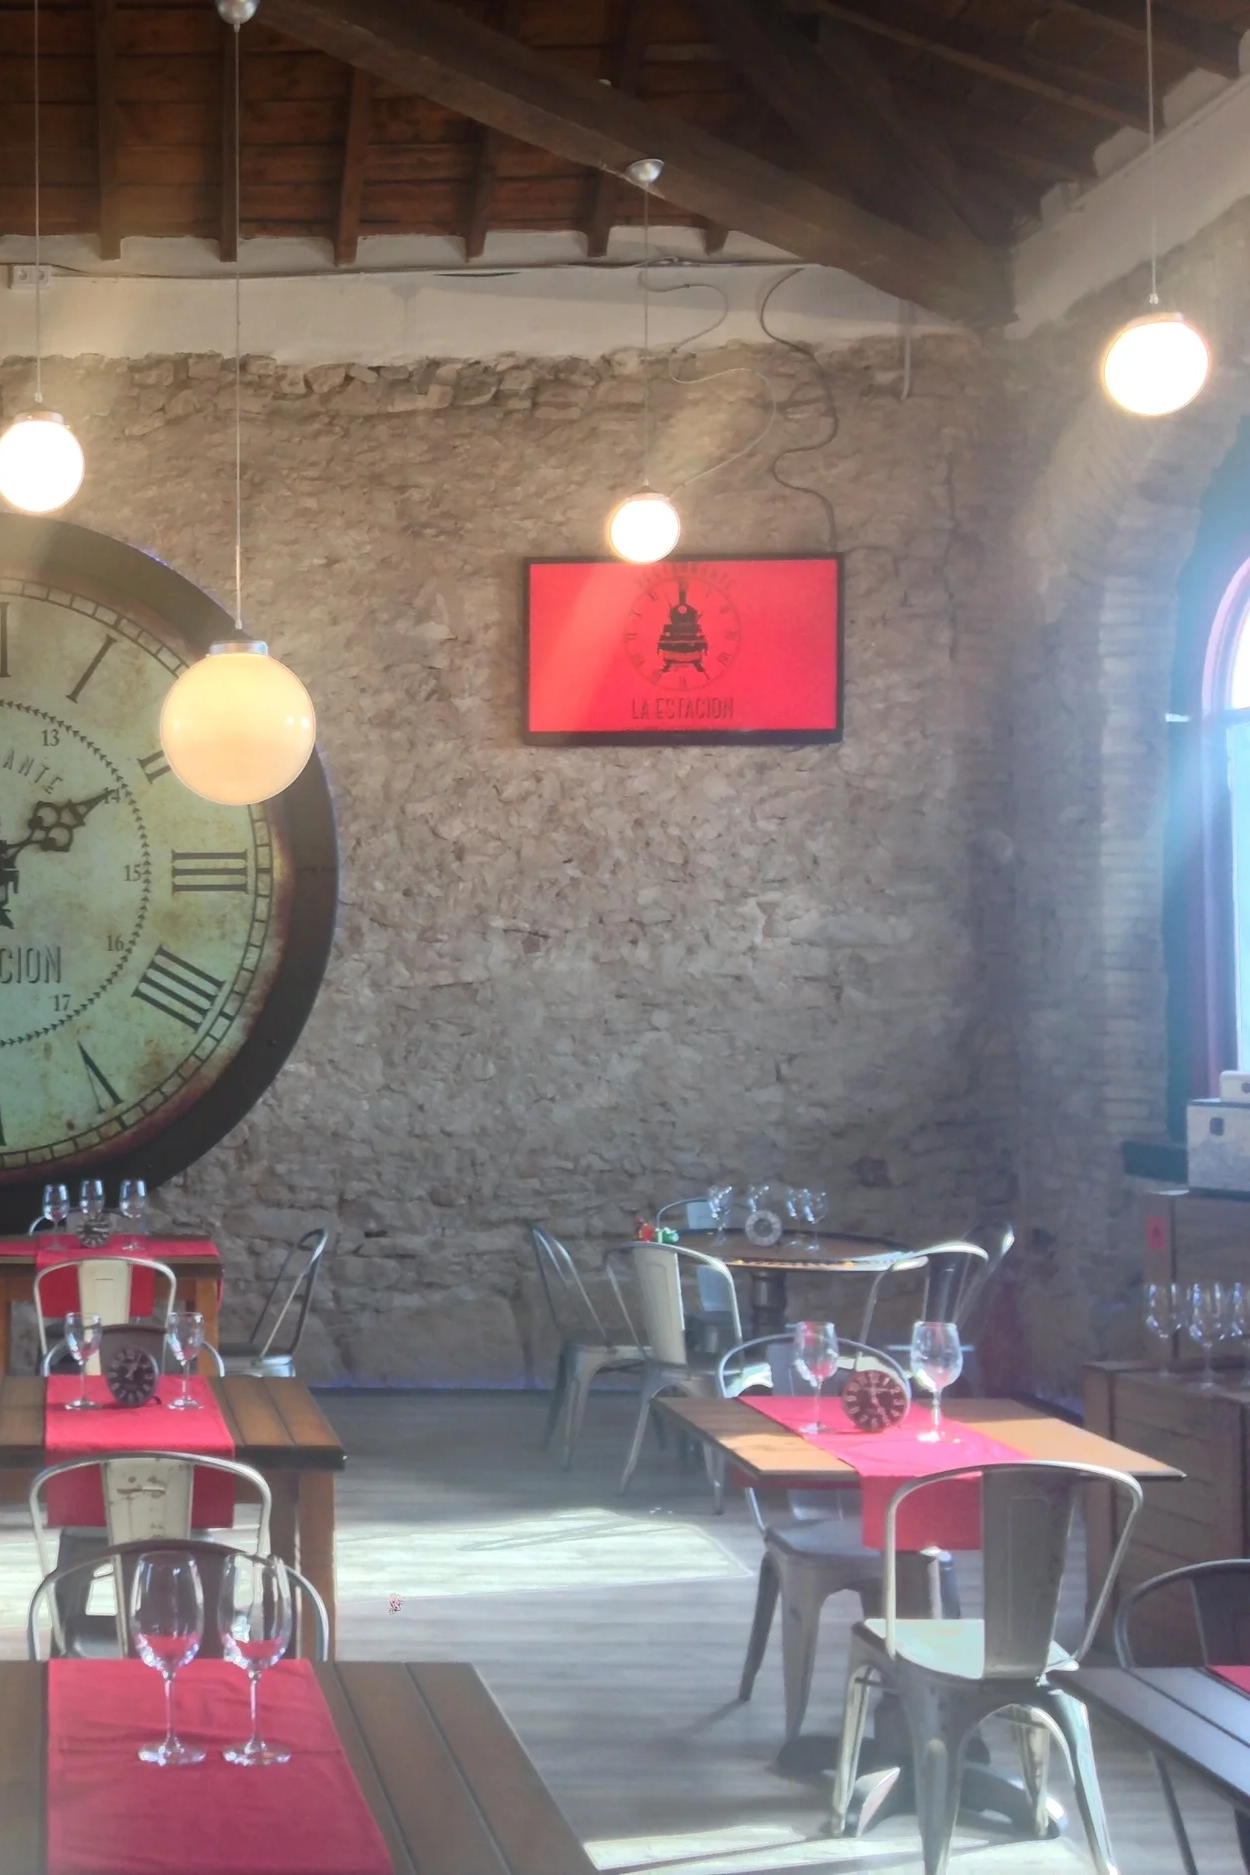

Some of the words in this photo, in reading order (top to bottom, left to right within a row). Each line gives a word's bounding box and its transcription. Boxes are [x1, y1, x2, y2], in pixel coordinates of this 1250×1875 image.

[66, 634, 117, 703] I
[632, 698, 650, 720] LA
[656, 698, 734, 720] ESTACION
[41, 729, 60, 747] 13
[123, 864, 142, 882] 15
[171, 849, 250, 895] III
[106, 934, 125, 952] 16
[130, 944, 232, 1034] IIII
[53, 994, 71, 1012] 17
[77, 1040, 124, 1114] V
